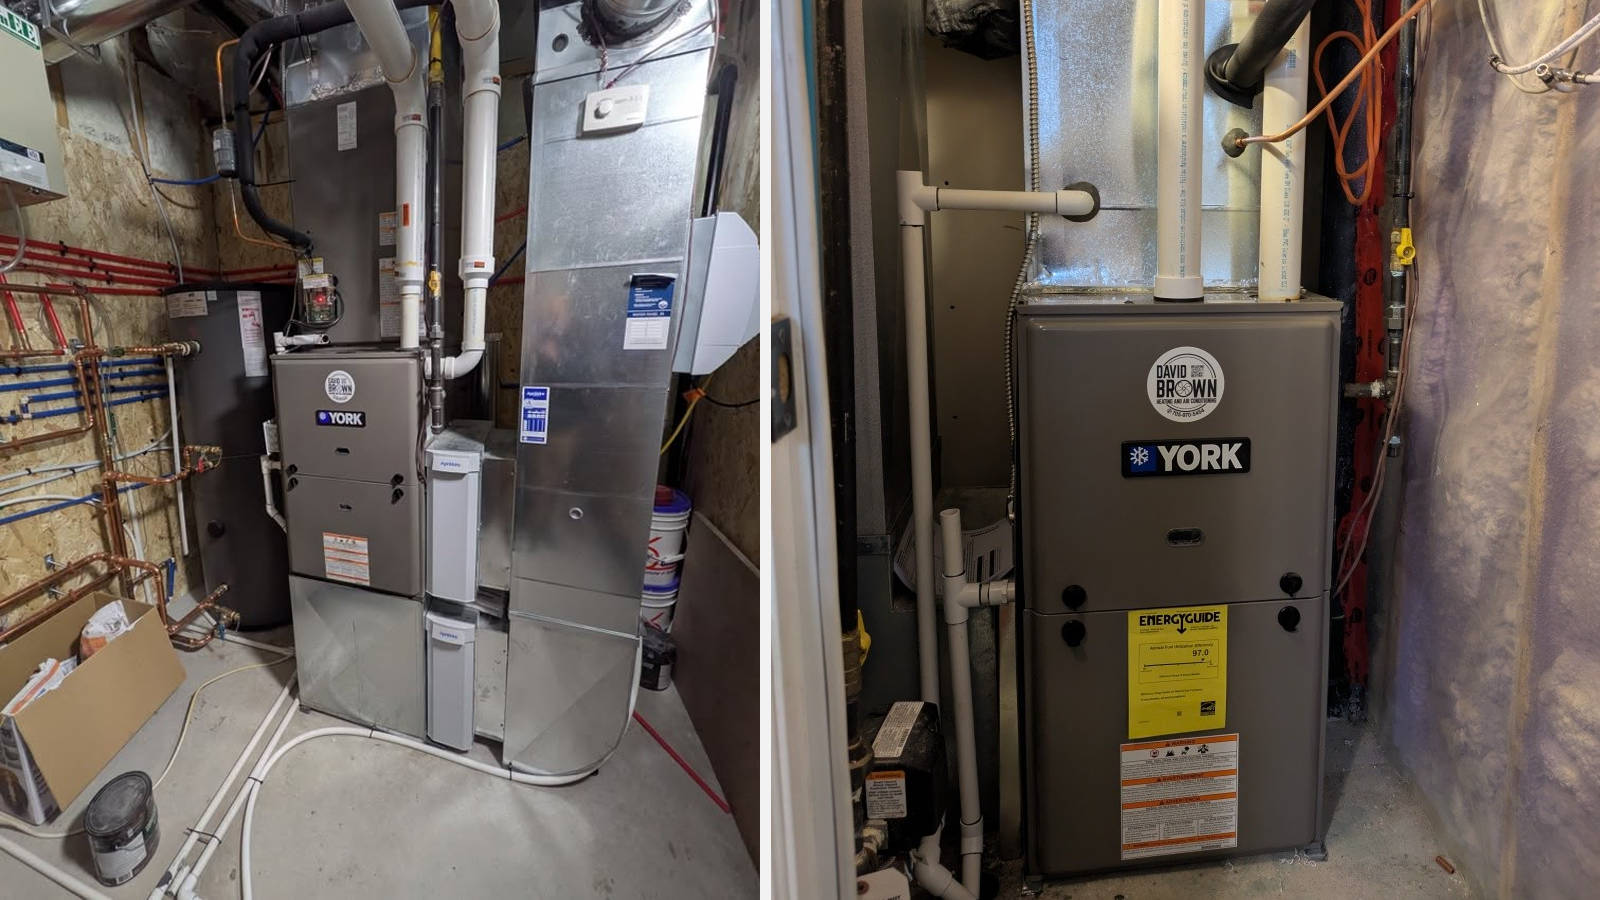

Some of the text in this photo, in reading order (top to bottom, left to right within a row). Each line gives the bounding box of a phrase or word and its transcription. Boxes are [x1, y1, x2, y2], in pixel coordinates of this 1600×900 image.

[1156, 365, 1186, 378] DAVID
[1156, 379, 1217, 398] BROWN
[328, 411, 363, 426] YORK
[1157, 443, 1243, 471] YORK
[1139, 612, 1220, 628] ENERGYGUIDE
[1192, 648, 1209, 657] 97.0
